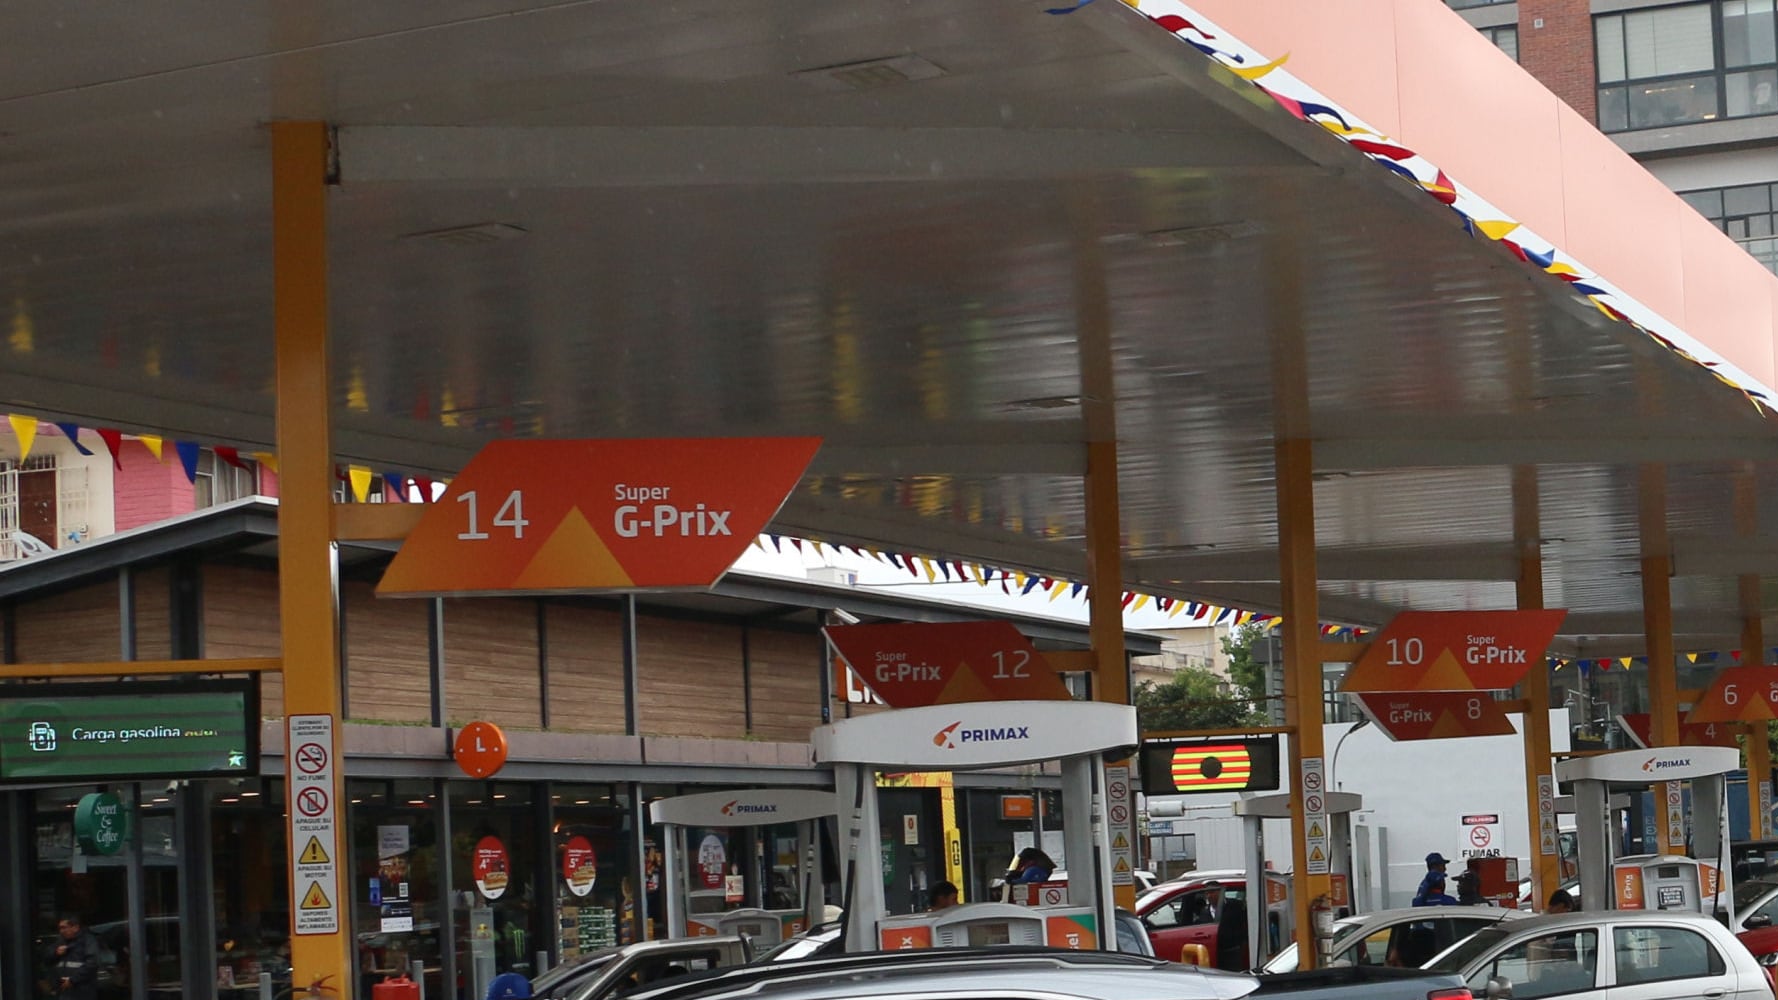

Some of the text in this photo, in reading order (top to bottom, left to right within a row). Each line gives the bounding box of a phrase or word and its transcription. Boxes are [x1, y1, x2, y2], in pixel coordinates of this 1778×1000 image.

[614, 484, 670, 503] Super
[457, 490, 529, 540] 14
[614, 504, 732, 538] G-Prix
[1466, 634, 1495, 645] Super
[875, 651, 906, 663] Super
[1386, 637, 1424, 666] 10
[1466, 645, 1527, 665] G-Prix
[875, 662, 942, 682] G-Prix
[992, 650, 1031, 679] 12
[1724, 684, 1738, 705] 6
[1389, 709, 1432, 724] G-Prix
[1467, 698, 1481, 720] 8
[72, 728, 115, 743] Carga
[119, 726, 180, 742] gasolina
[961, 727, 1029, 742] PRIMAX
[1705, 723, 1717, 739] 4
[1656, 759, 1691, 768] PRIMAX
[737, 804, 777, 814] PRIMAX
[1462, 848, 1500, 858] FUMAR
